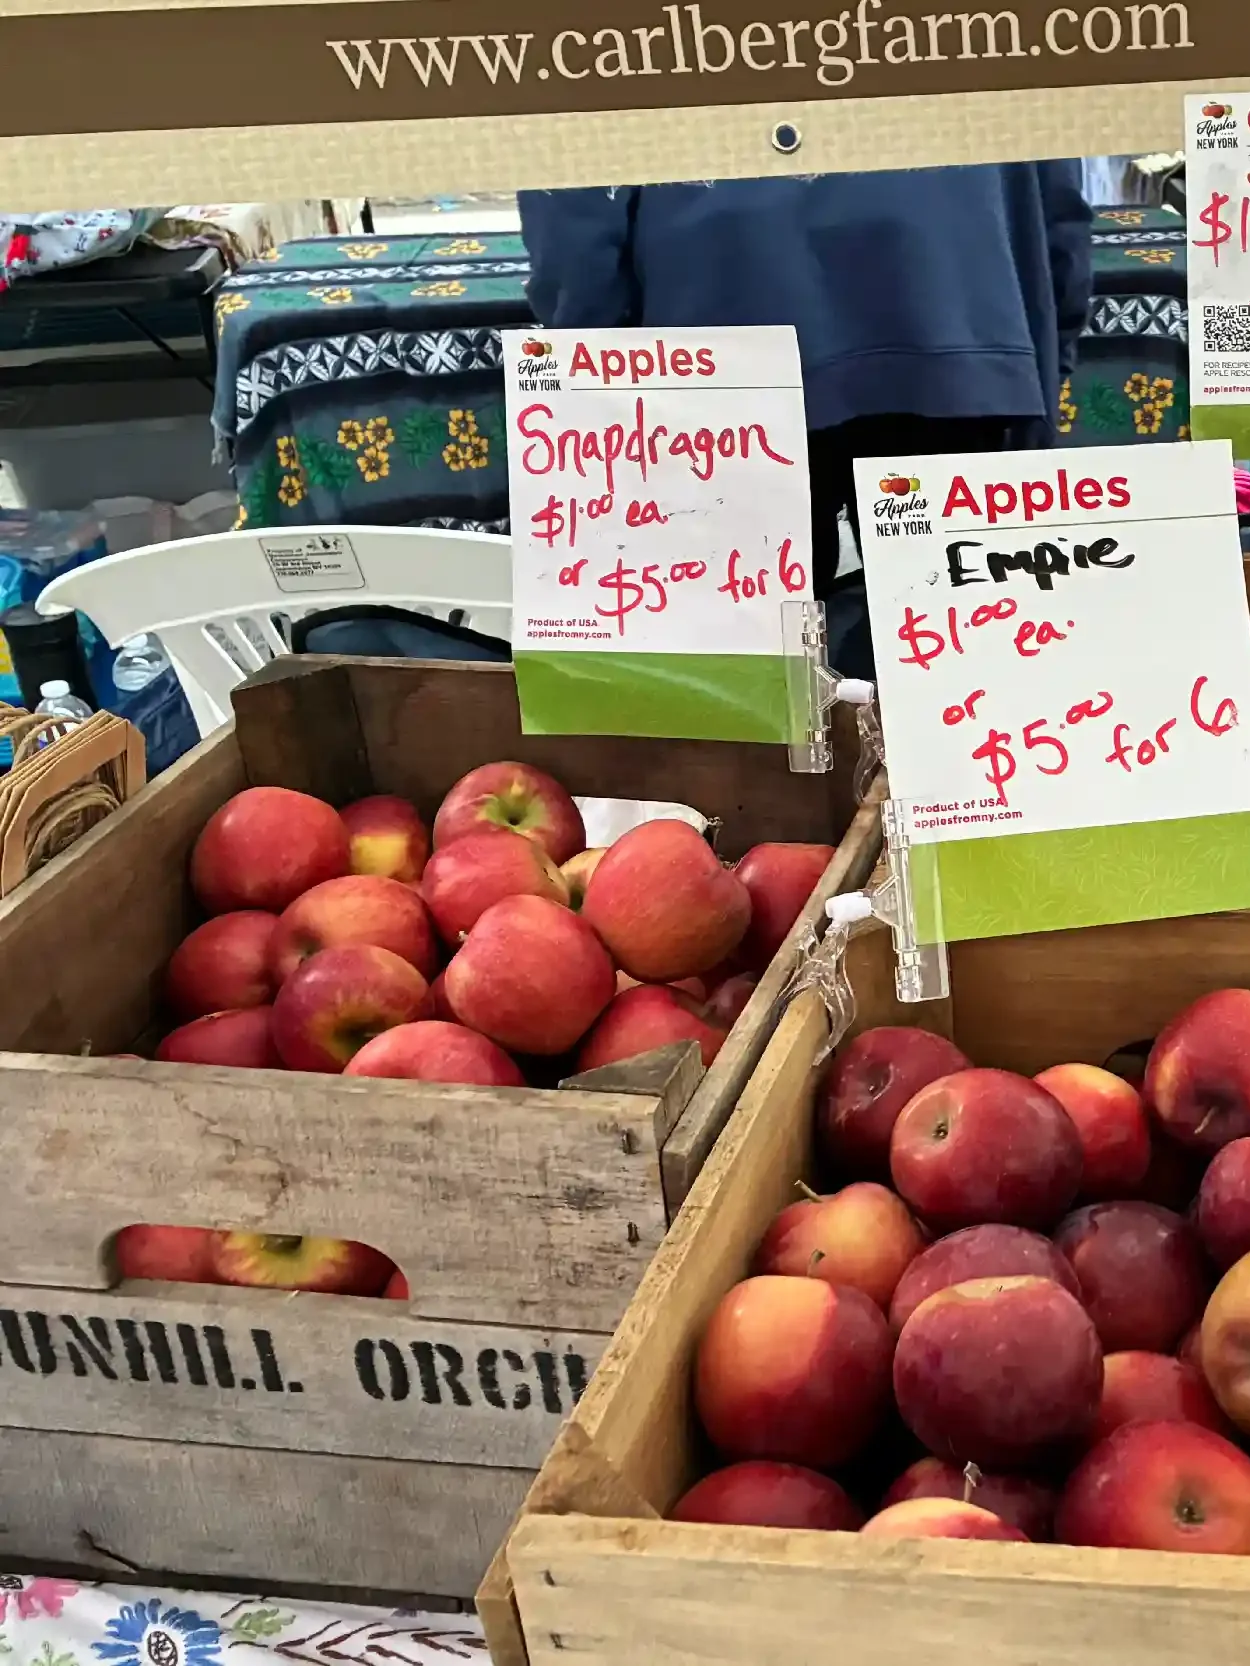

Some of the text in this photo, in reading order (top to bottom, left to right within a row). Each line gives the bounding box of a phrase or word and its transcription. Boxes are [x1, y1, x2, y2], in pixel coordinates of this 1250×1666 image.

[325, 0, 1195, 88] www.carlbergfarm.com
[1196, 116, 1237, 137] Apples
[1196, 137, 1238, 150] NEW YORK
[518, 356, 558, 378] Apples
[568, 340, 717, 384] Apples
[518, 380, 562, 391] NEW YORK
[517, 397, 794, 494] Snapdragon
[874, 493, 929, 520] Apples
[942, 469, 1131, 524] Apples
[531, 494, 669, 547] $1.00 ea.
[876, 520, 932, 538] NEW YORK
[945, 537, 1134, 591] Empire
[558, 538, 806, 636] or $5.00 for 6
[527, 618, 598, 627] Product of USA
[527, 630, 612, 640] applesfromny.com
[898, 598, 1075, 671] $1.00 ea.
[942, 689, 986, 726] or
[972, 675, 1240, 808] $5.00 for 6
[912, 798, 1004, 814] Product of USA
[914, 810, 1023, 829] applesfromny.com
[0, 1309, 304, 1393] UNHILL
